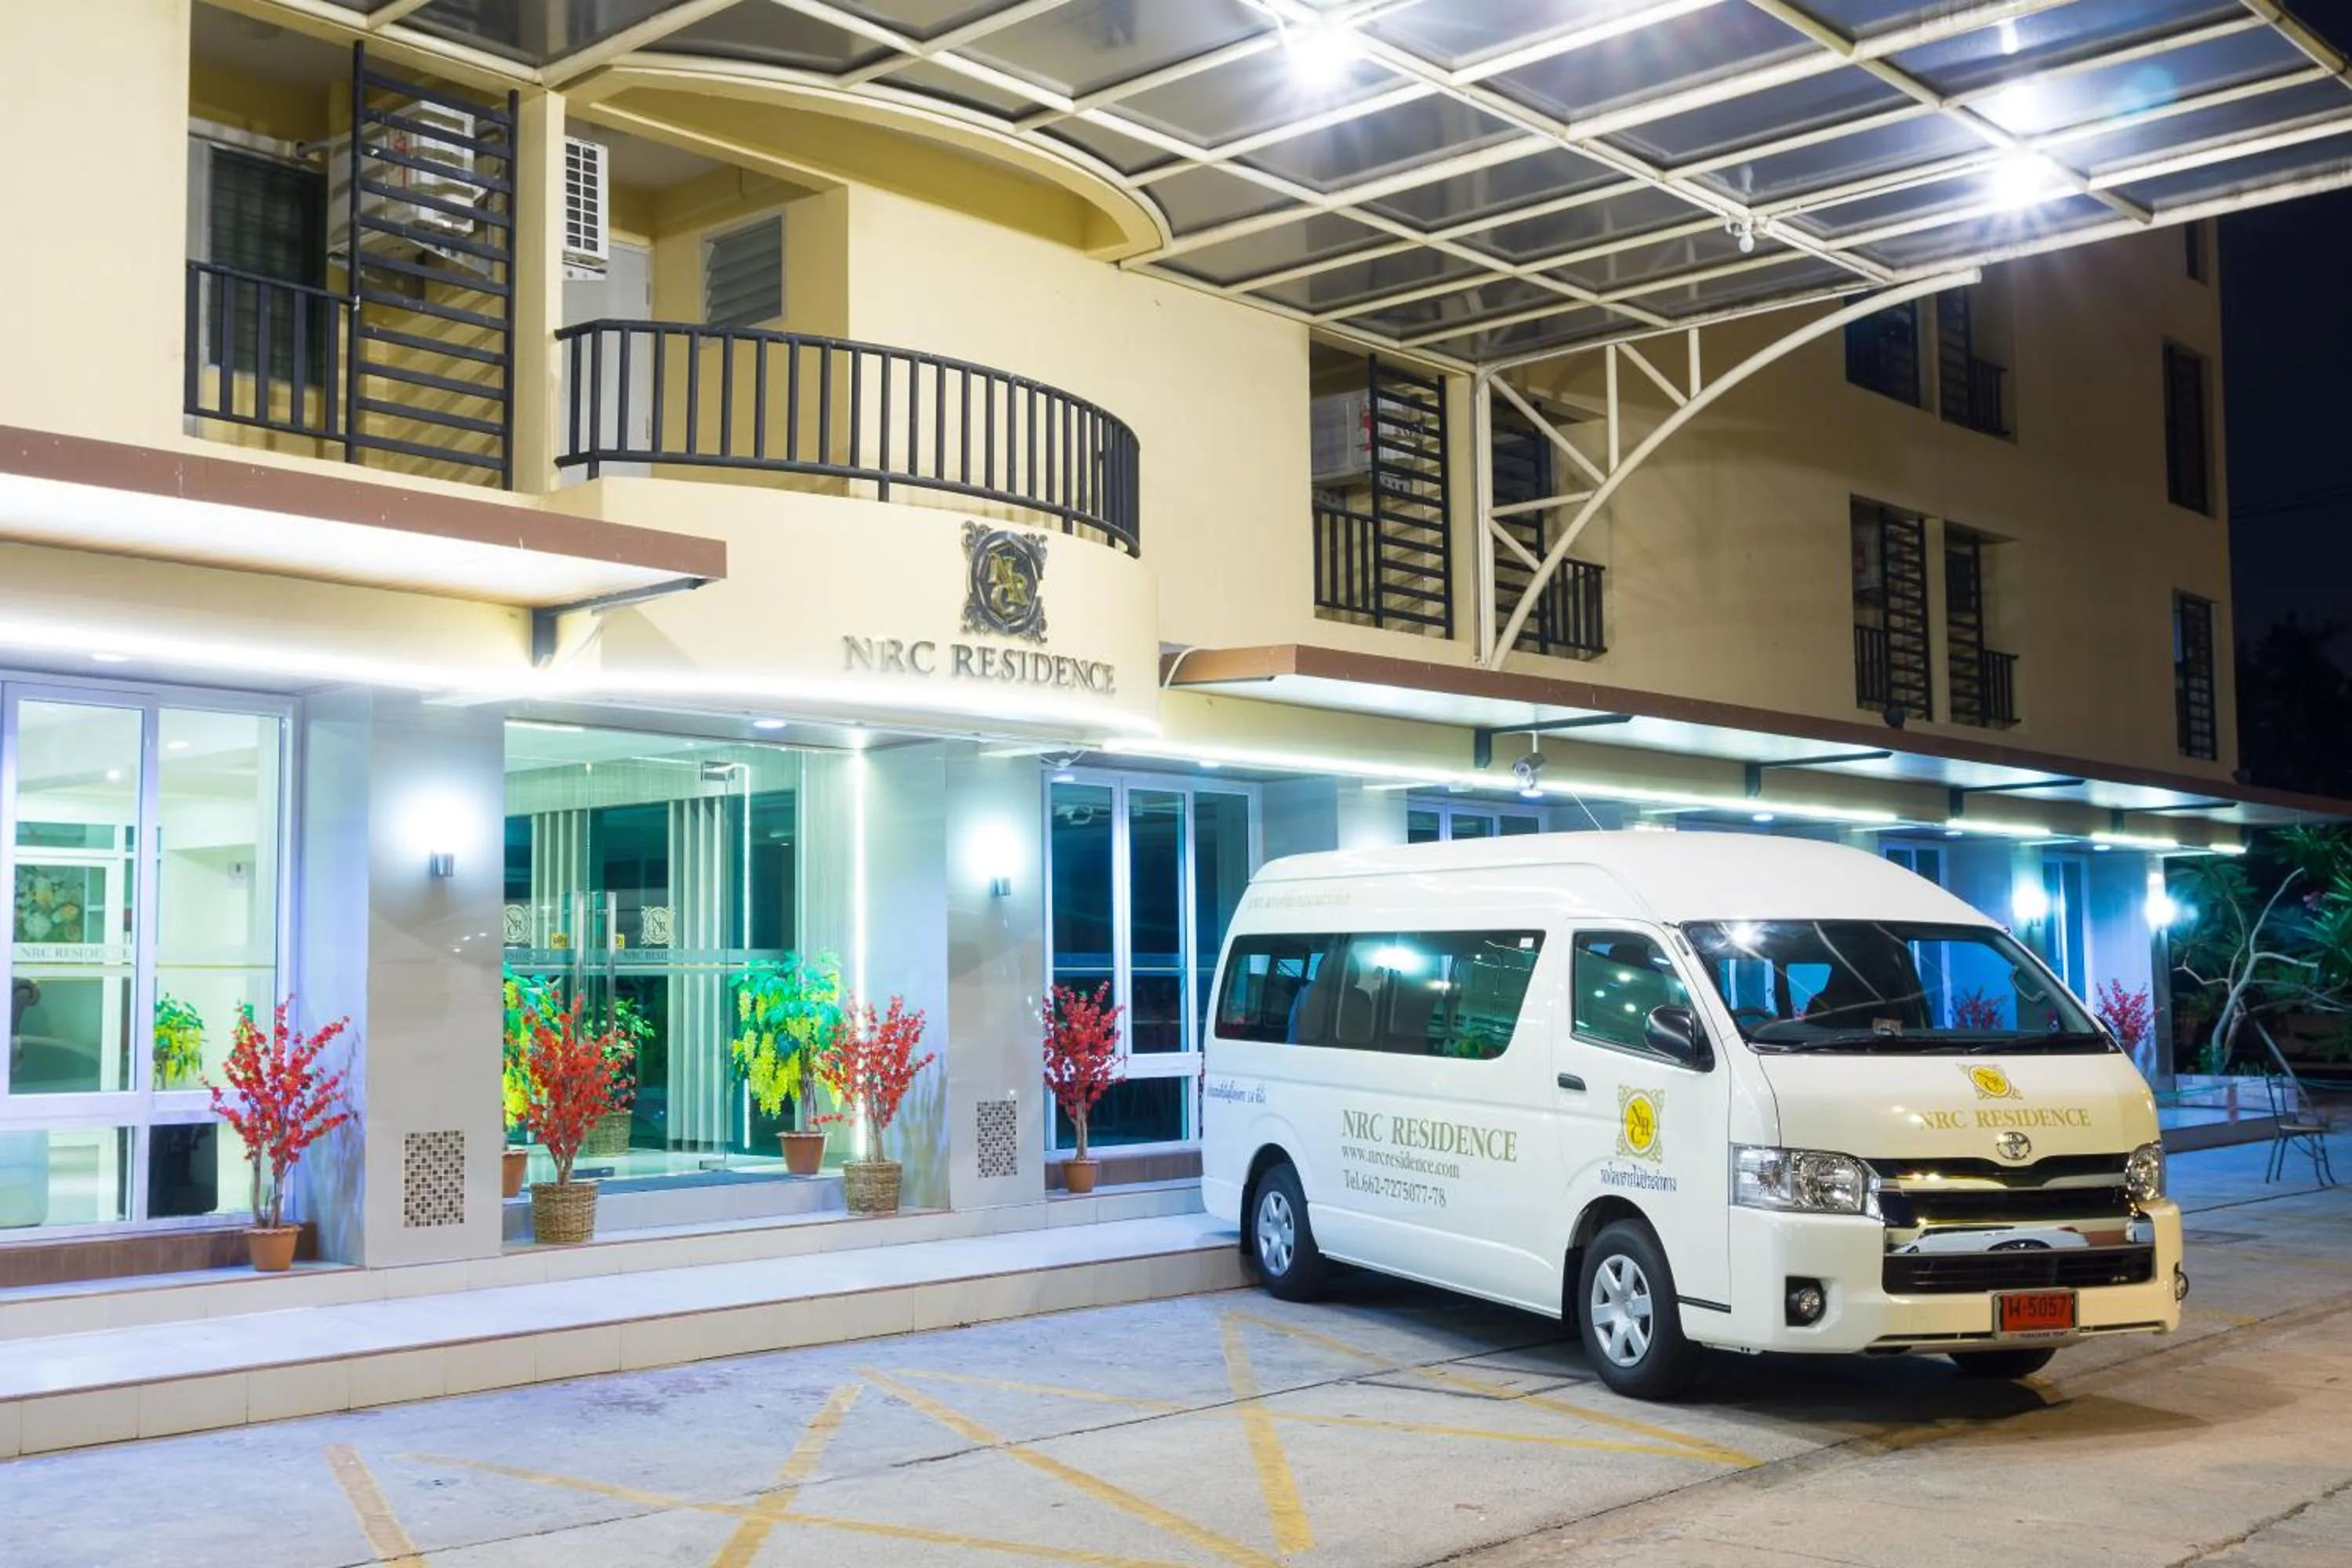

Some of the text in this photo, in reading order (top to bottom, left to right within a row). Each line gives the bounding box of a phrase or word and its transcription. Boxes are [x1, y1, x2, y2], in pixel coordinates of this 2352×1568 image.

[842, 633, 1116, 695] NRC RESIDENCE
[1341, 1109, 1518, 1163] NRC RESIDENCE
[1920, 1107, 2092, 1130] NRC RESIDENCE
[1341, 1145, 1461, 1179] www.nrcresidence.com
